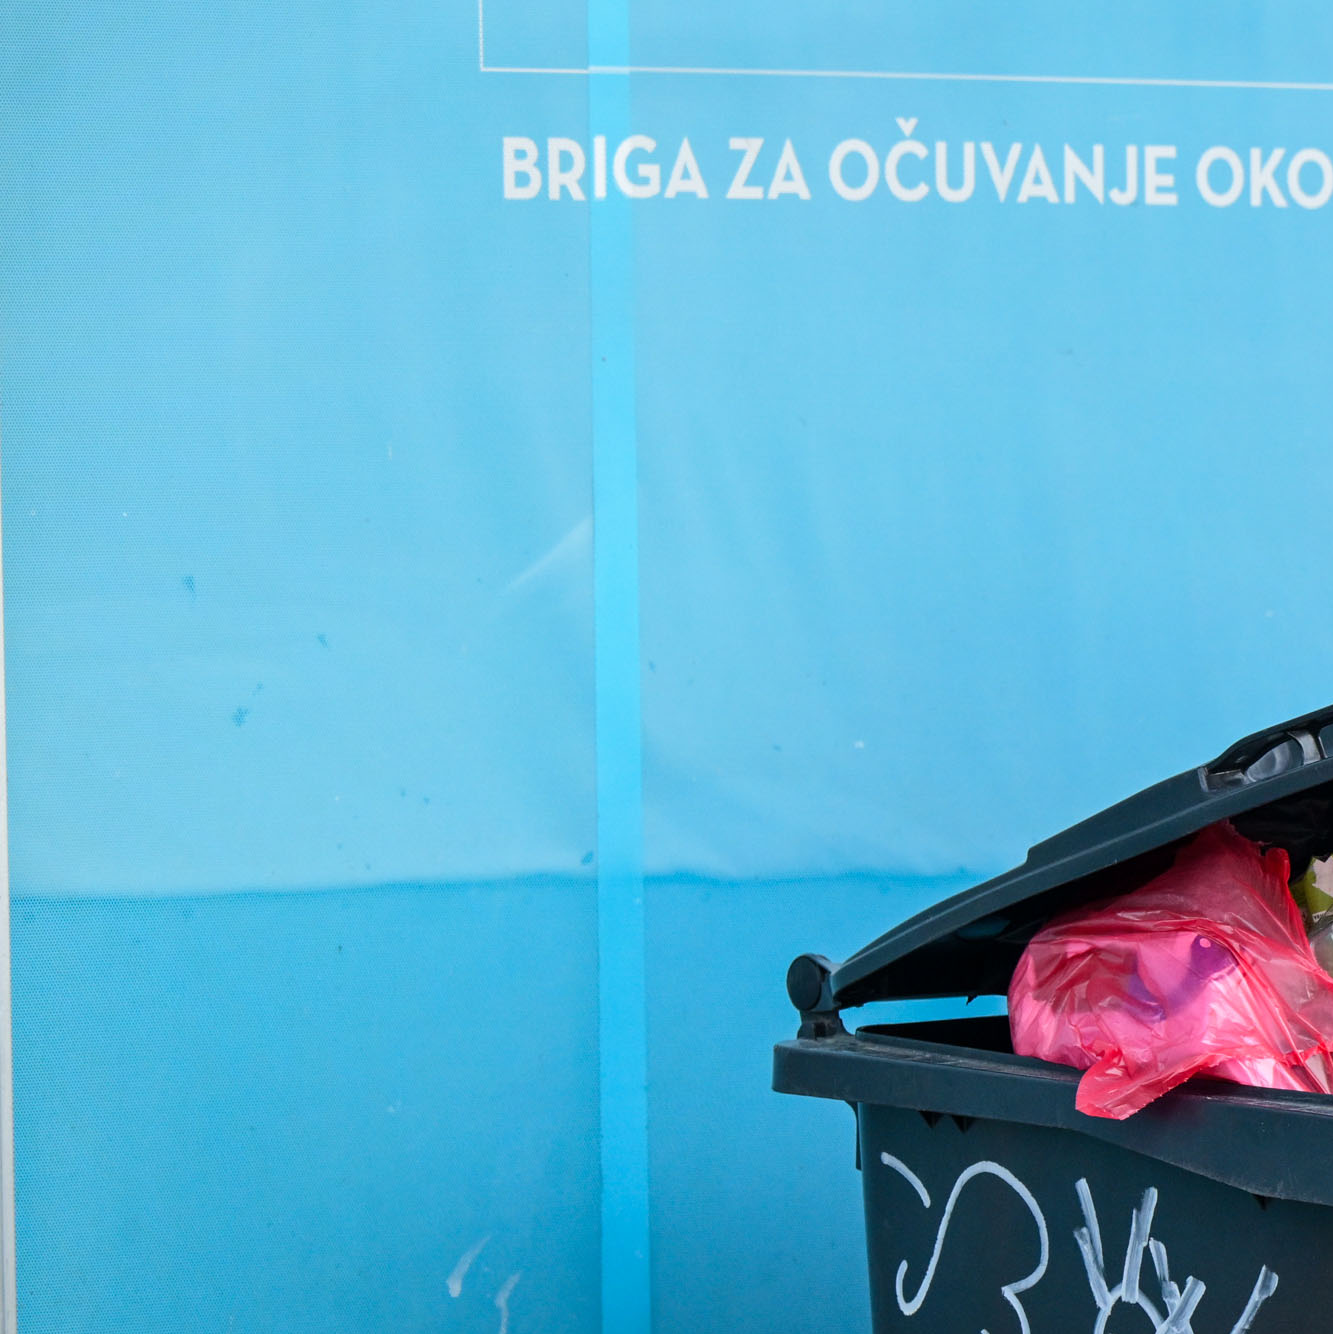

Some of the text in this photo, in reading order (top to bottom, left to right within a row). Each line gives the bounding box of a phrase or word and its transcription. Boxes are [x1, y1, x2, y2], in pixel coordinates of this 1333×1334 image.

[503, 134, 709, 201] BRIGA
[726, 137, 811, 201] ZA
[829, 116, 1178, 206] OČUVANJE
